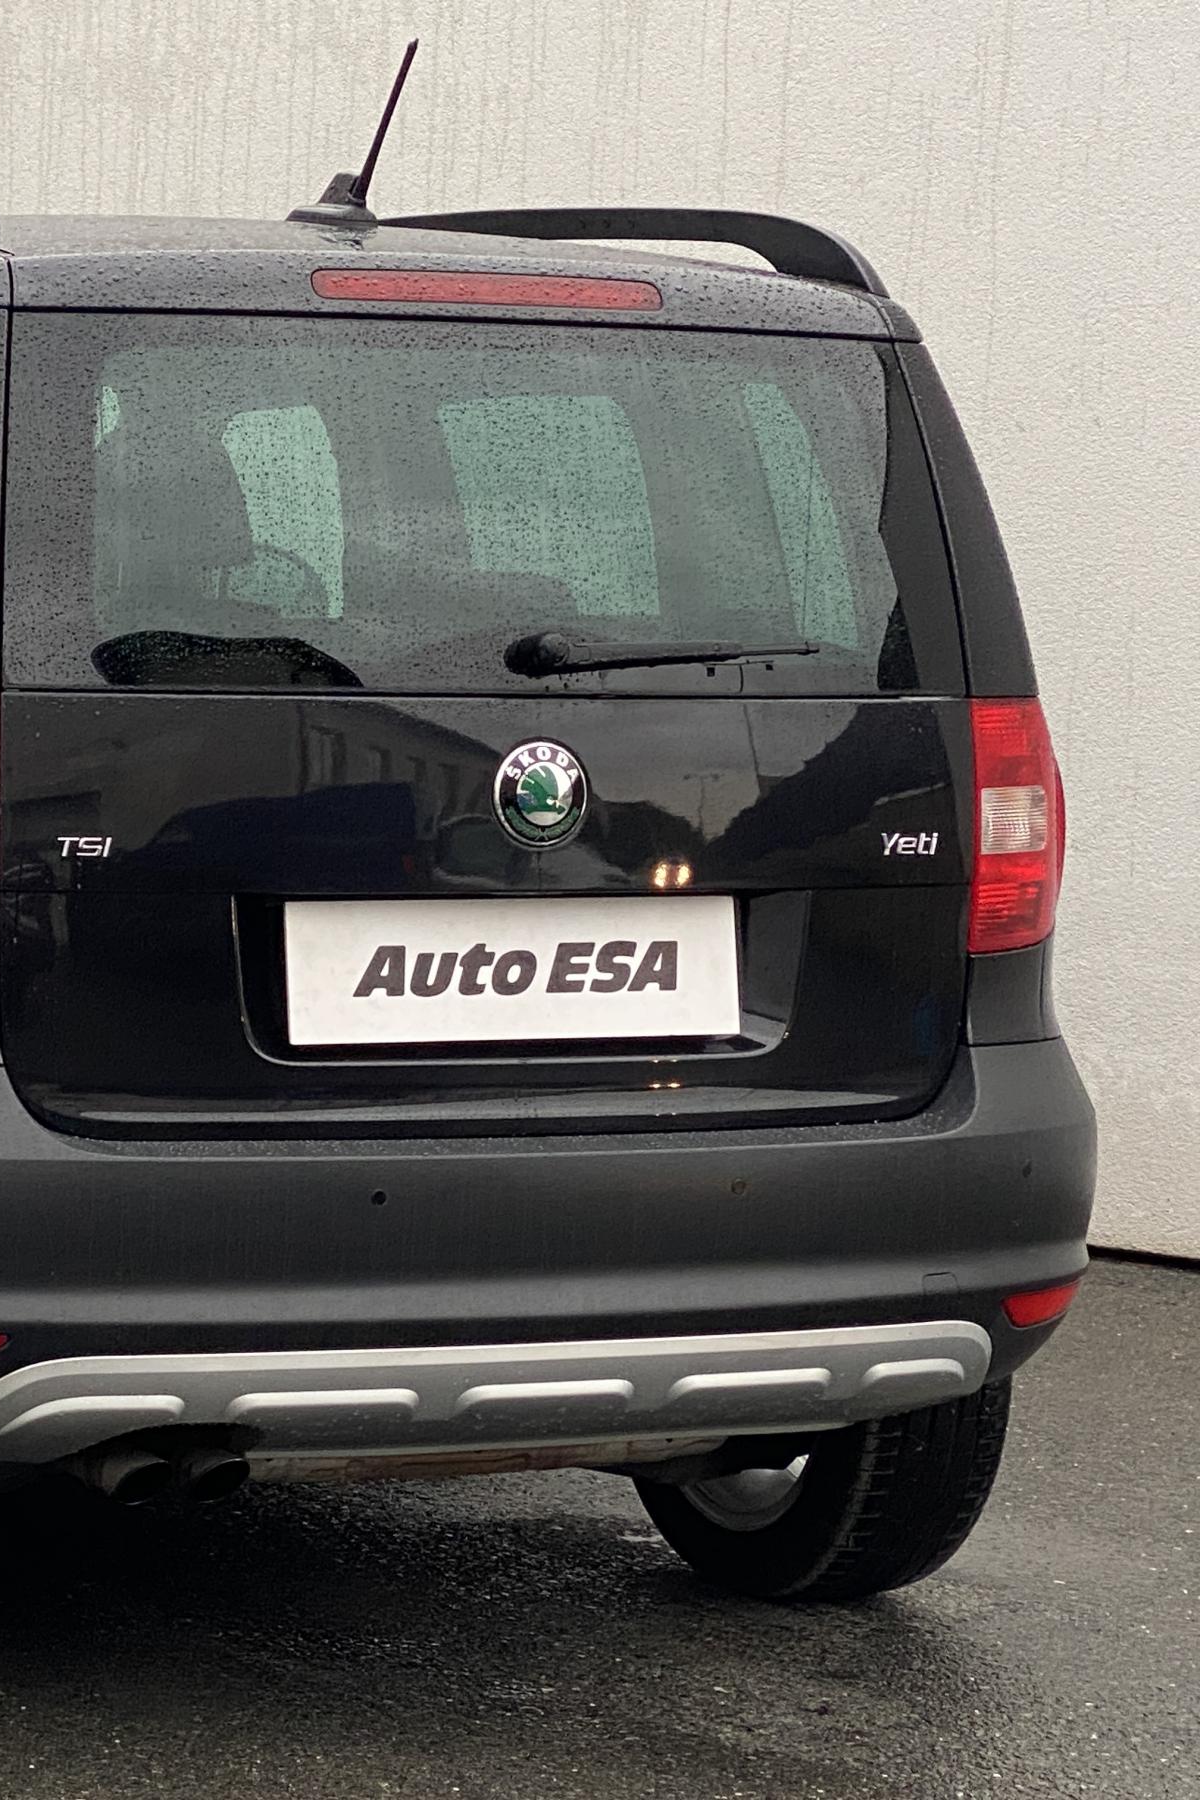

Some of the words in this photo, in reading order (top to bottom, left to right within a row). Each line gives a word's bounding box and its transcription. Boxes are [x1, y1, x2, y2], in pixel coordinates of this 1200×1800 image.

[57, 837, 112, 857] TSI
[881, 832, 938, 855] Yeti
[353, 943, 537, 997] Auto
[546, 941, 678, 993] ESA
